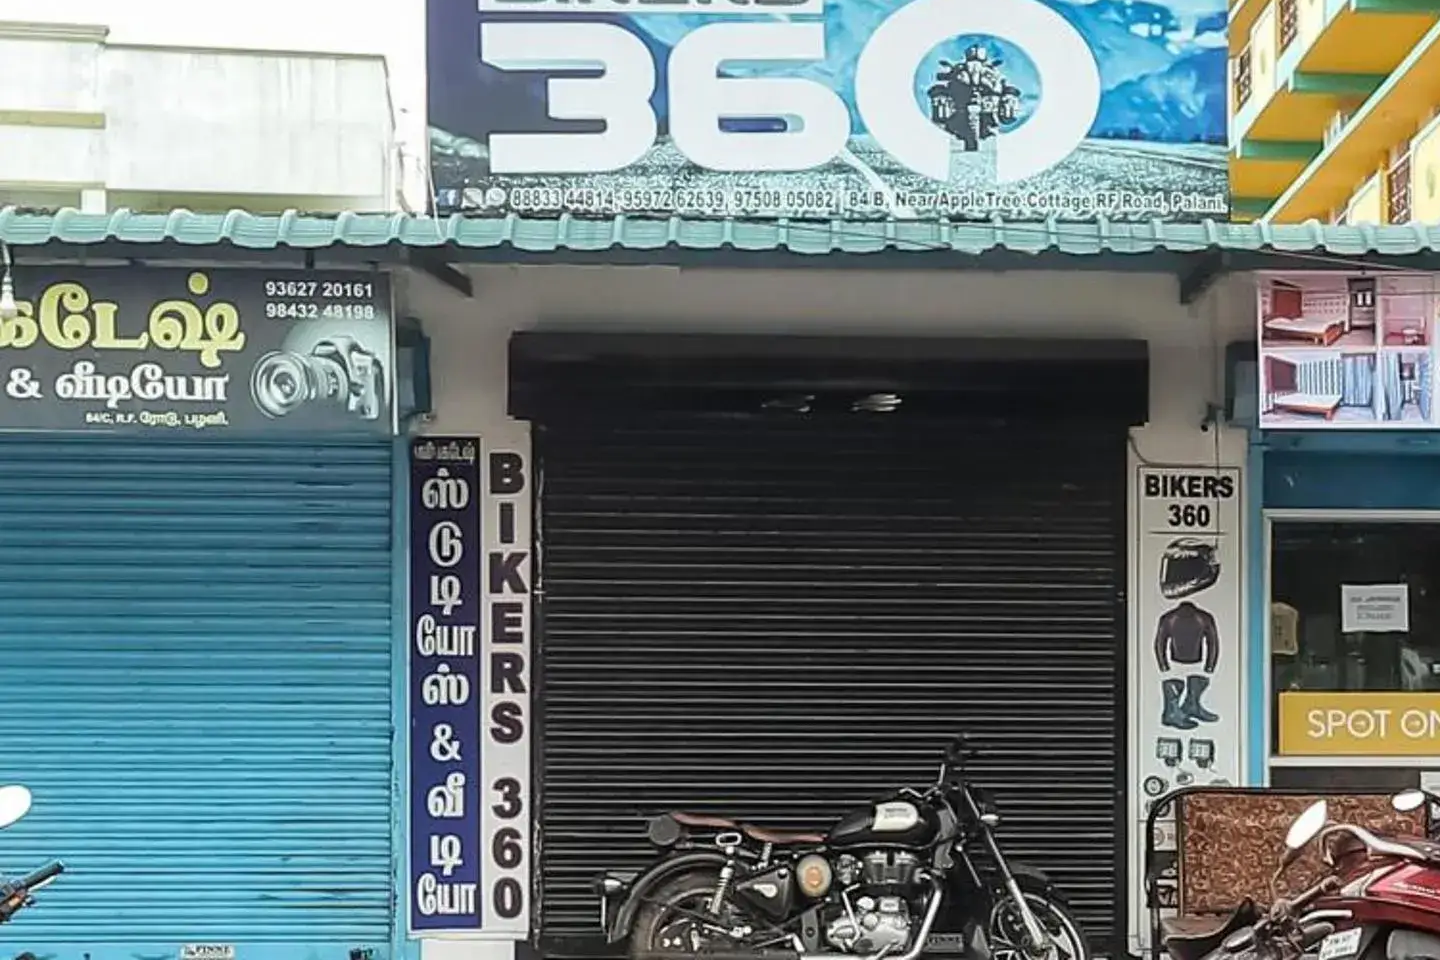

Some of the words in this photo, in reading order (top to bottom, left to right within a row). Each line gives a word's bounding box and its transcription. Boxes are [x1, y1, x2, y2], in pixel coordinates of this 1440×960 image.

[734, 189, 780, 209] 97508
[265, 281, 318, 297] 93627
[322, 282, 373, 298] 20161
[265, 302, 319, 318] 98432
[6, 368, 43, 398] &
[55, 360, 230, 409] வீடியோ
[1144, 474, 1234, 498] BIKERS
[1168, 504, 1210, 527] 360
[489, 452, 529, 744] BIKERS
[1307, 709, 1392, 739] SPOT
[491, 777, 523, 919] 360
